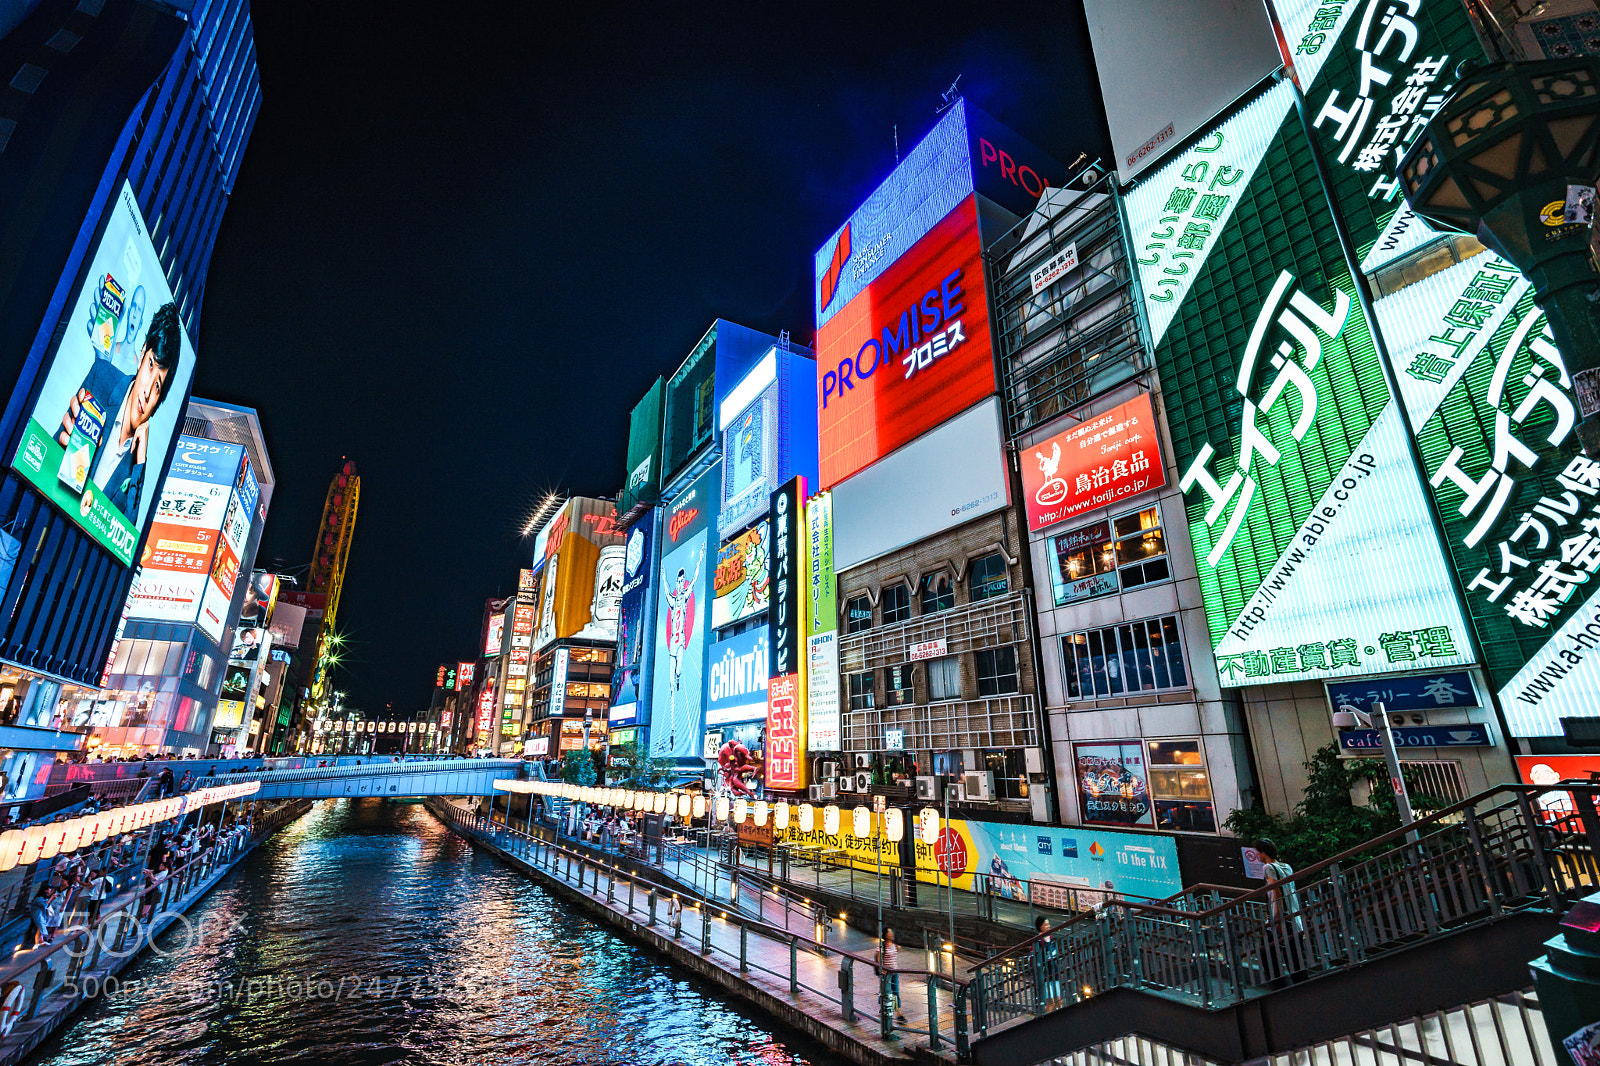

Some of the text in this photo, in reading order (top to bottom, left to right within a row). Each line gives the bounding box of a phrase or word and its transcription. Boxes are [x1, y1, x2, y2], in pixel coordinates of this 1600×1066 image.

[1295, 0, 1349, 55] お部
[1313, 0, 1421, 164] エイブ
[1352, 54, 1450, 172] 株式会社
[1127, 126, 1174, 167] 06-6262-1313
[979, 137, 1050, 199] PRO
[1137, 131, 1225, 266] いい暮らし
[852, 241, 872, 263] SMBC
[852, 232, 892, 273] CONSUMER
[1149, 165, 1244, 303] いい部屋で
[853, 247, 885, 282] FINANCE
[1034, 248, 1074, 283] 広告募集中
[1034, 257, 1076, 290] 06-6262-1313
[822, 267, 963, 410] PROMISE
[902, 319, 966, 380] プロミス
[1178, 269, 1352, 570] エイブル
[1075, 450, 1150, 495] 鳥治食品
[951, 491, 999, 517] 06-6262-1313
[1039, 475, 1149, 524] http://www.toriji.co.jp/
[668, 508, 699, 542] Glico
[1466, 449, 1600, 603] エイブル保
[717, 543, 740, 565] かぜに
[1231, 452, 1376, 642] http://www.able.co.jp
[713, 555, 742, 591] 改源
[811, 634, 833, 646] NIHON
[1217, 625, 1458, 680] 不動産賃貸・管理
[1517, 604, 1600, 706] www.a-ho
[771, 680, 794, 697] スーパー
[1335, 676, 1469, 706] ギャラリー 香
[770, 696, 796, 783] 玉出
[936, 851, 967, 872] FREE!
[938, 832, 961, 853] TAX
[1037, 841, 1052, 849] CITY
[1116, 850, 1128, 865] TO
[1131, 853, 1147, 867] the
[1149, 854, 1168, 870] KIX
